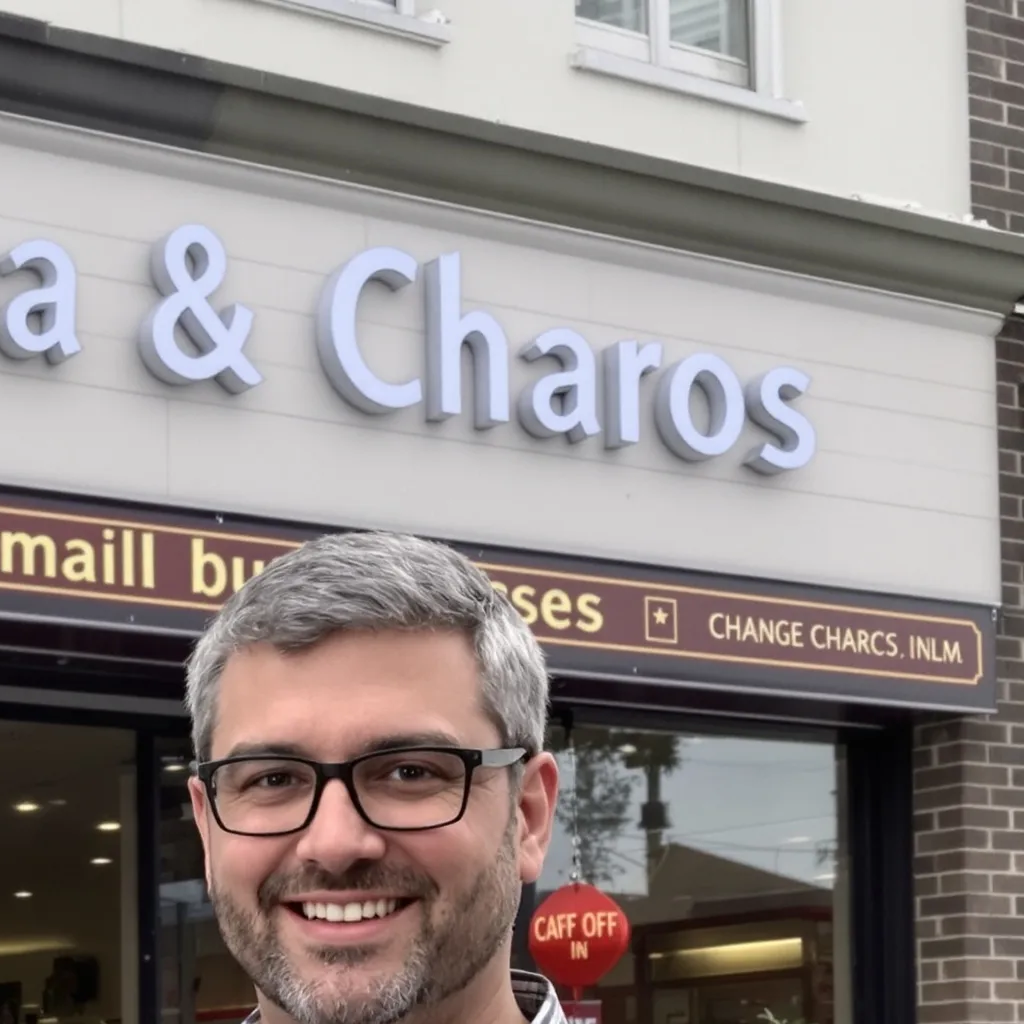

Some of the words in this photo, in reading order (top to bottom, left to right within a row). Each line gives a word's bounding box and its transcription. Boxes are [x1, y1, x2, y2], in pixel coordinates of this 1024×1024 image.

[139, 224, 263, 394] &
[317, 247, 816, 474] Charos
[708, 612, 803, 647] CHANGE
[909, 635, 963, 664] INLM
[534, 913, 577, 942] CAFF
[582, 912, 618, 938] OFF
[570, 941, 588, 960] IN
